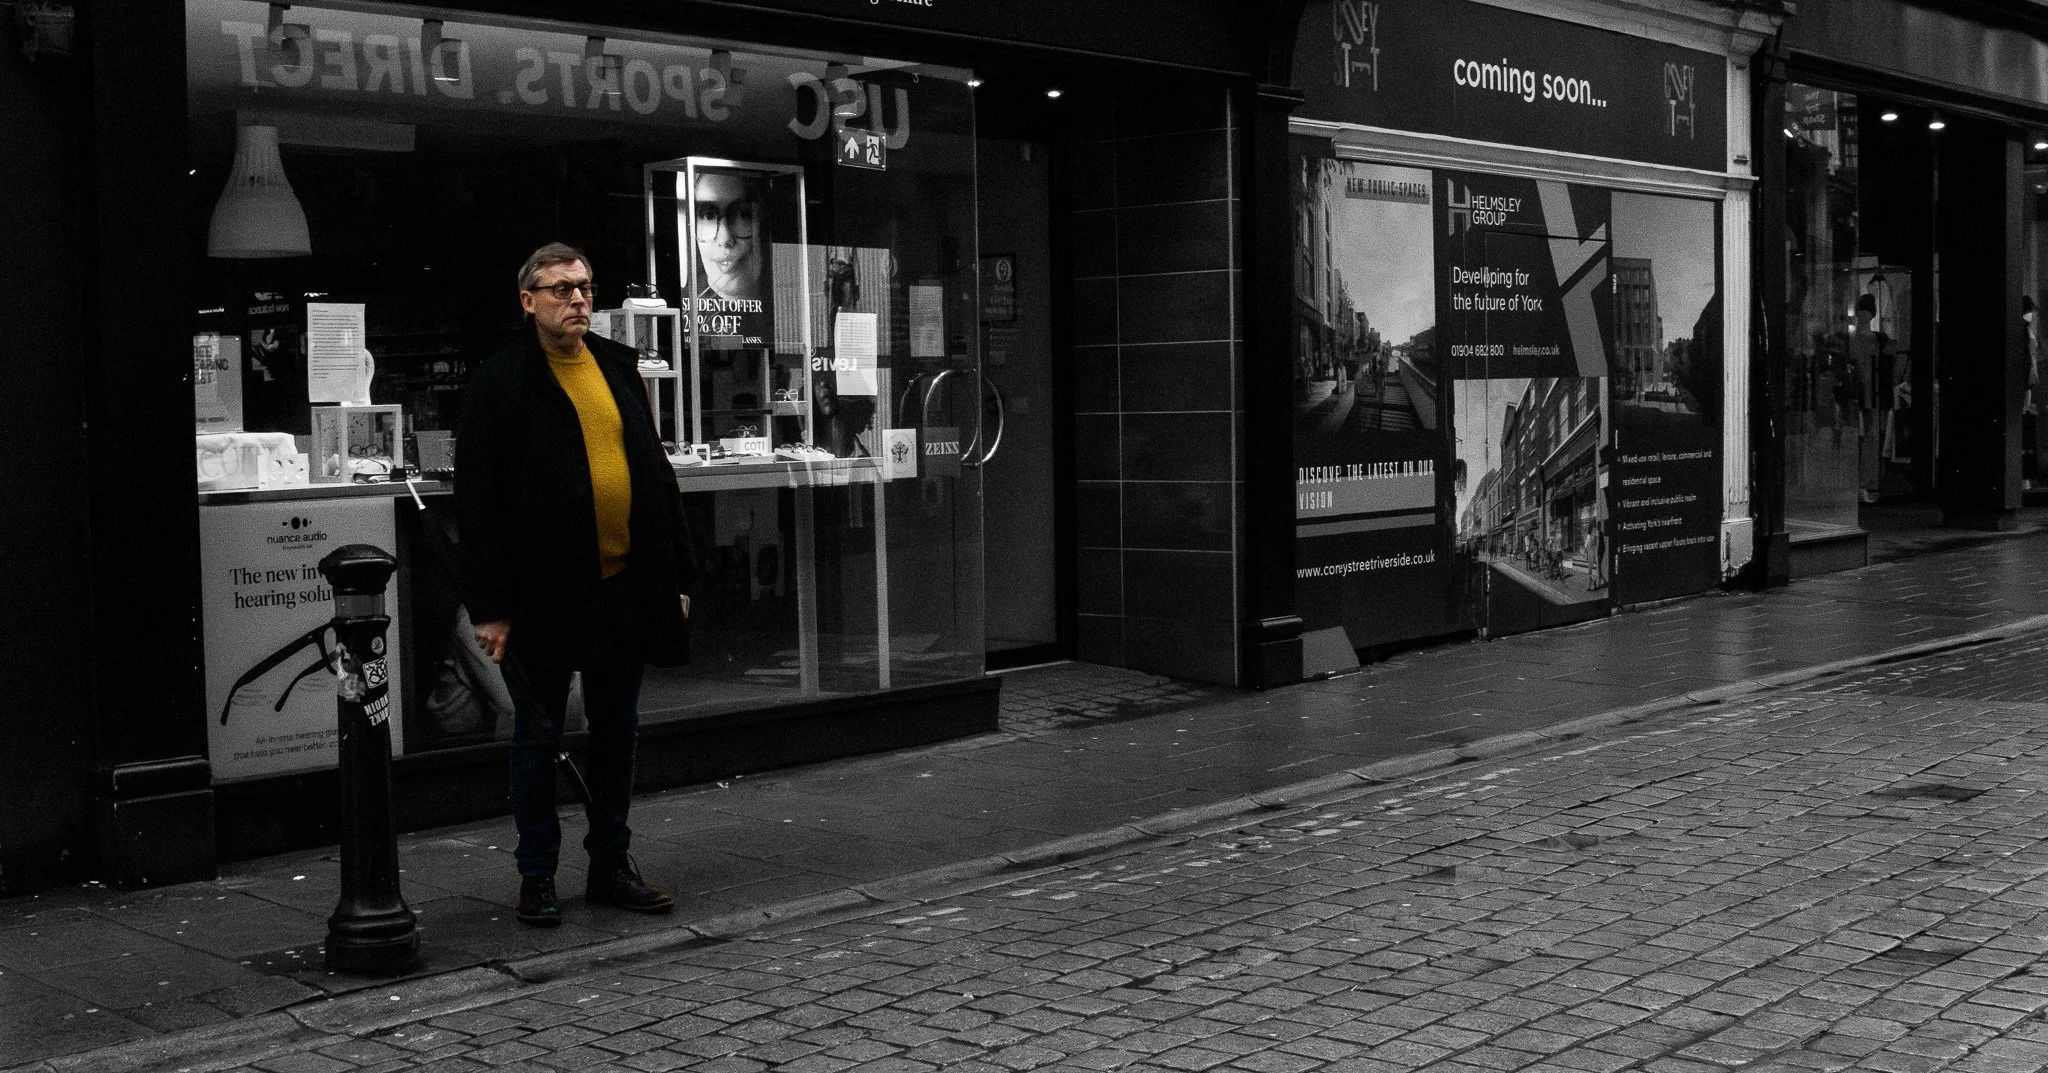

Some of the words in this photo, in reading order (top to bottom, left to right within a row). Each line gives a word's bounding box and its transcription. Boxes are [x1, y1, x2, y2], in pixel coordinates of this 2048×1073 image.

[1453, 57, 1536, 103] coming
[1542, 73, 1607, 108] soon...
[1346, 177, 1364, 193] NEW
[1471, 195, 1521, 212] HELMSLEY
[1472, 210, 1507, 226] GROUP
[1453, 266, 1513, 288] Developing
[1515, 268, 1530, 286] for
[728, 299, 763, 313] OFFER
[1453, 292, 1472, 310] the
[1474, 292, 1506, 311] future
[1508, 293, 1520, 311] of
[1521, 294, 1543, 312] York
[683, 314, 710, 333] 2%
[711, 315, 742, 334] OFF
[1451, 344, 1474, 357] 01904
[1474, 344, 1489, 357] 682
[1490, 344, 1505, 356] 800
[1512, 344, 1560, 356] helmsley.co.uk
[925, 441, 960, 456] ZEISS
[1299, 465, 1341, 485] DISCOVE
[1346, 463, 1363, 481] THE
[1368, 461, 1399, 480] LATEST
[1403, 460, 1414, 477] ON
[1418, 459, 1434, 476] OUR
[1299, 490, 1333, 510] VISION
[1640, 497, 1649, 507] and
[266, 534, 301, 544] nuance
[302, 531, 328, 542] audio
[229, 567, 262, 586] The
[265, 568, 298, 583] new
[234, 589, 297, 610] hearing
